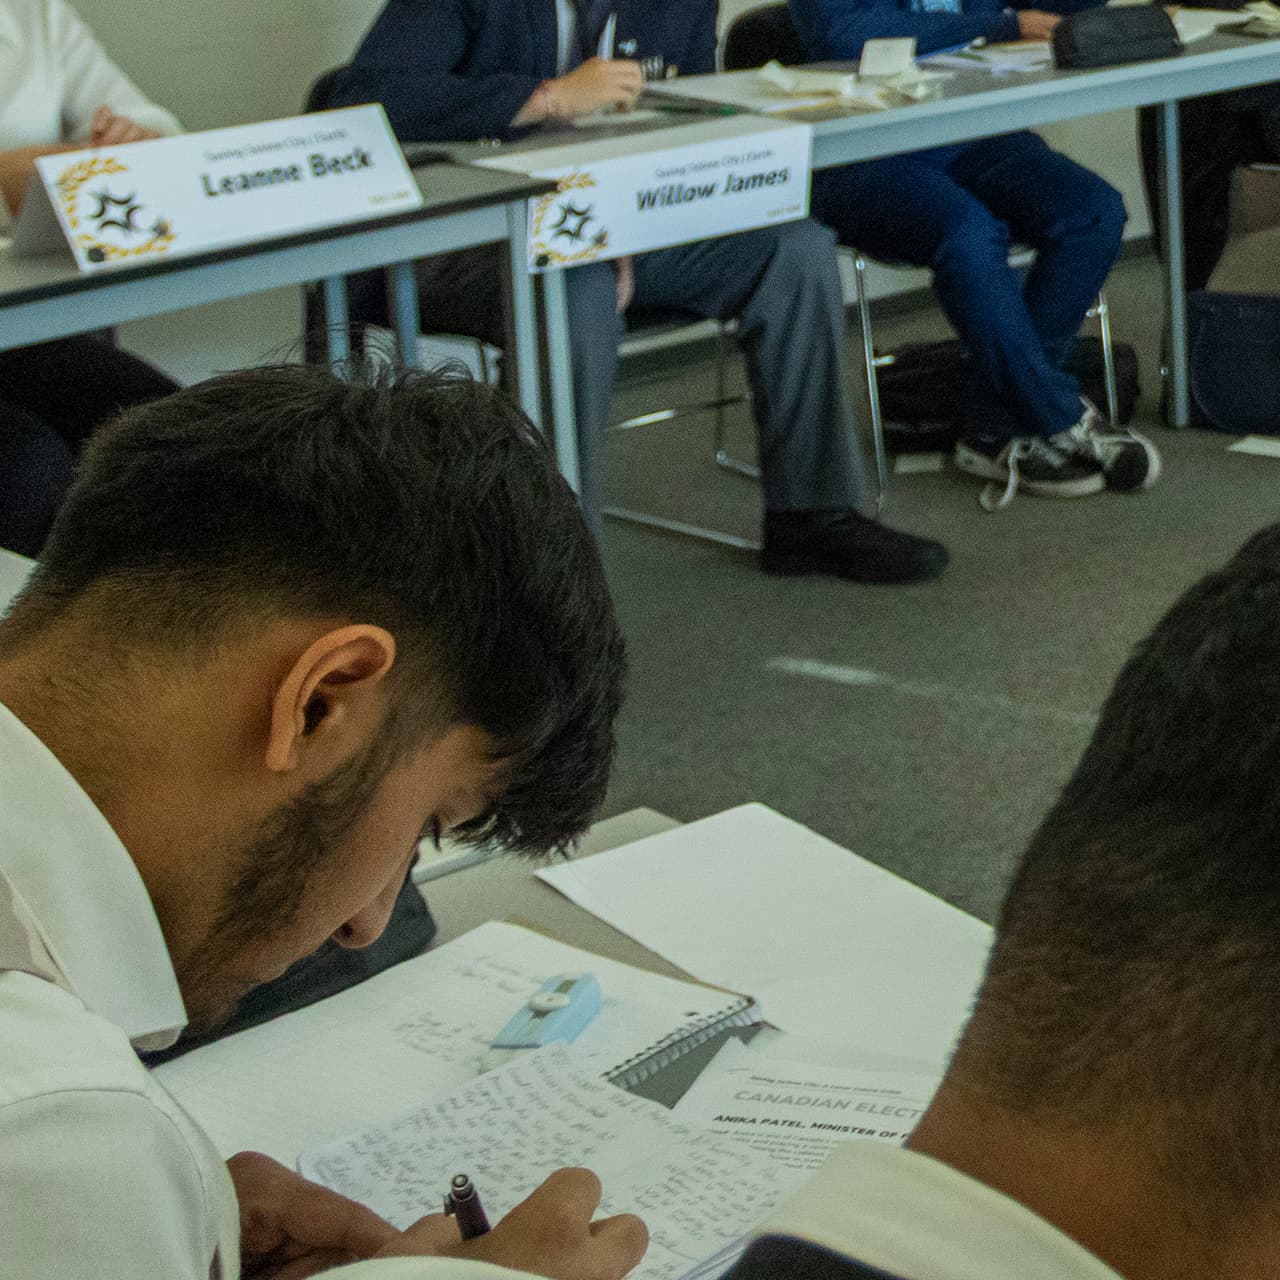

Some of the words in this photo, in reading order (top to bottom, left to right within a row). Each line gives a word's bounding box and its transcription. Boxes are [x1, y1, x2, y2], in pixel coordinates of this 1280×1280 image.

[200, 164, 303, 198] Leanne
[307, 146, 374, 177] Beck
[636, 182, 716, 212] Willow
[720, 166, 791, 196] James
[734, 1090, 852, 1110] CANADIAN
[712, 1114, 757, 1125] ANIKA
[809, 1121, 877, 1137] MINISTER
[878, 1130, 898, 1139] OF
